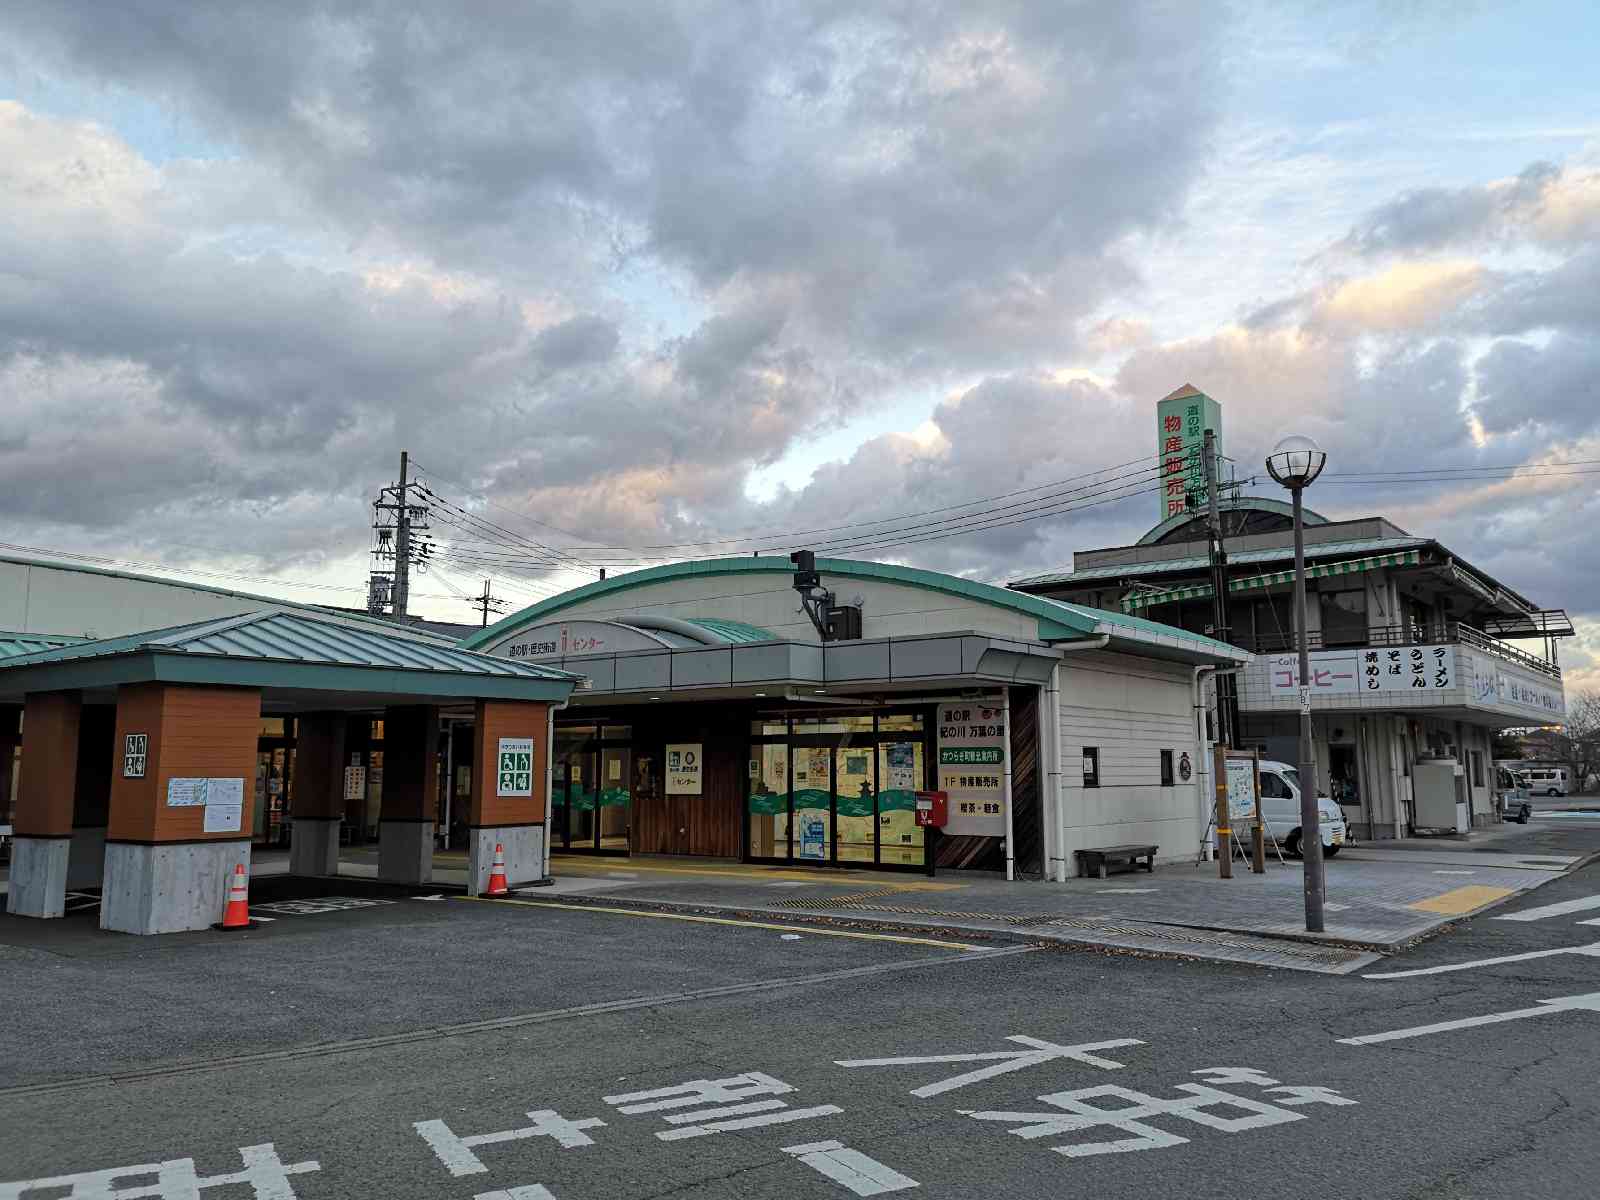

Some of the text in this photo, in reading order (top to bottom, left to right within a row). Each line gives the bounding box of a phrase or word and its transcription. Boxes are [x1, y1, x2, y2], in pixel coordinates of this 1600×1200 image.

[1365, 652, 1380, 690] 焼めし
[1387, 651, 1402, 675] そば
[1410, 649, 1426, 688] うどん
[1433, 647, 1448, 688] ラーメン
[1275, 669, 1353, 688] コーヒー
[944, 710, 970, 722] 道の駅
[941, 726, 965, 738] 紀の川
